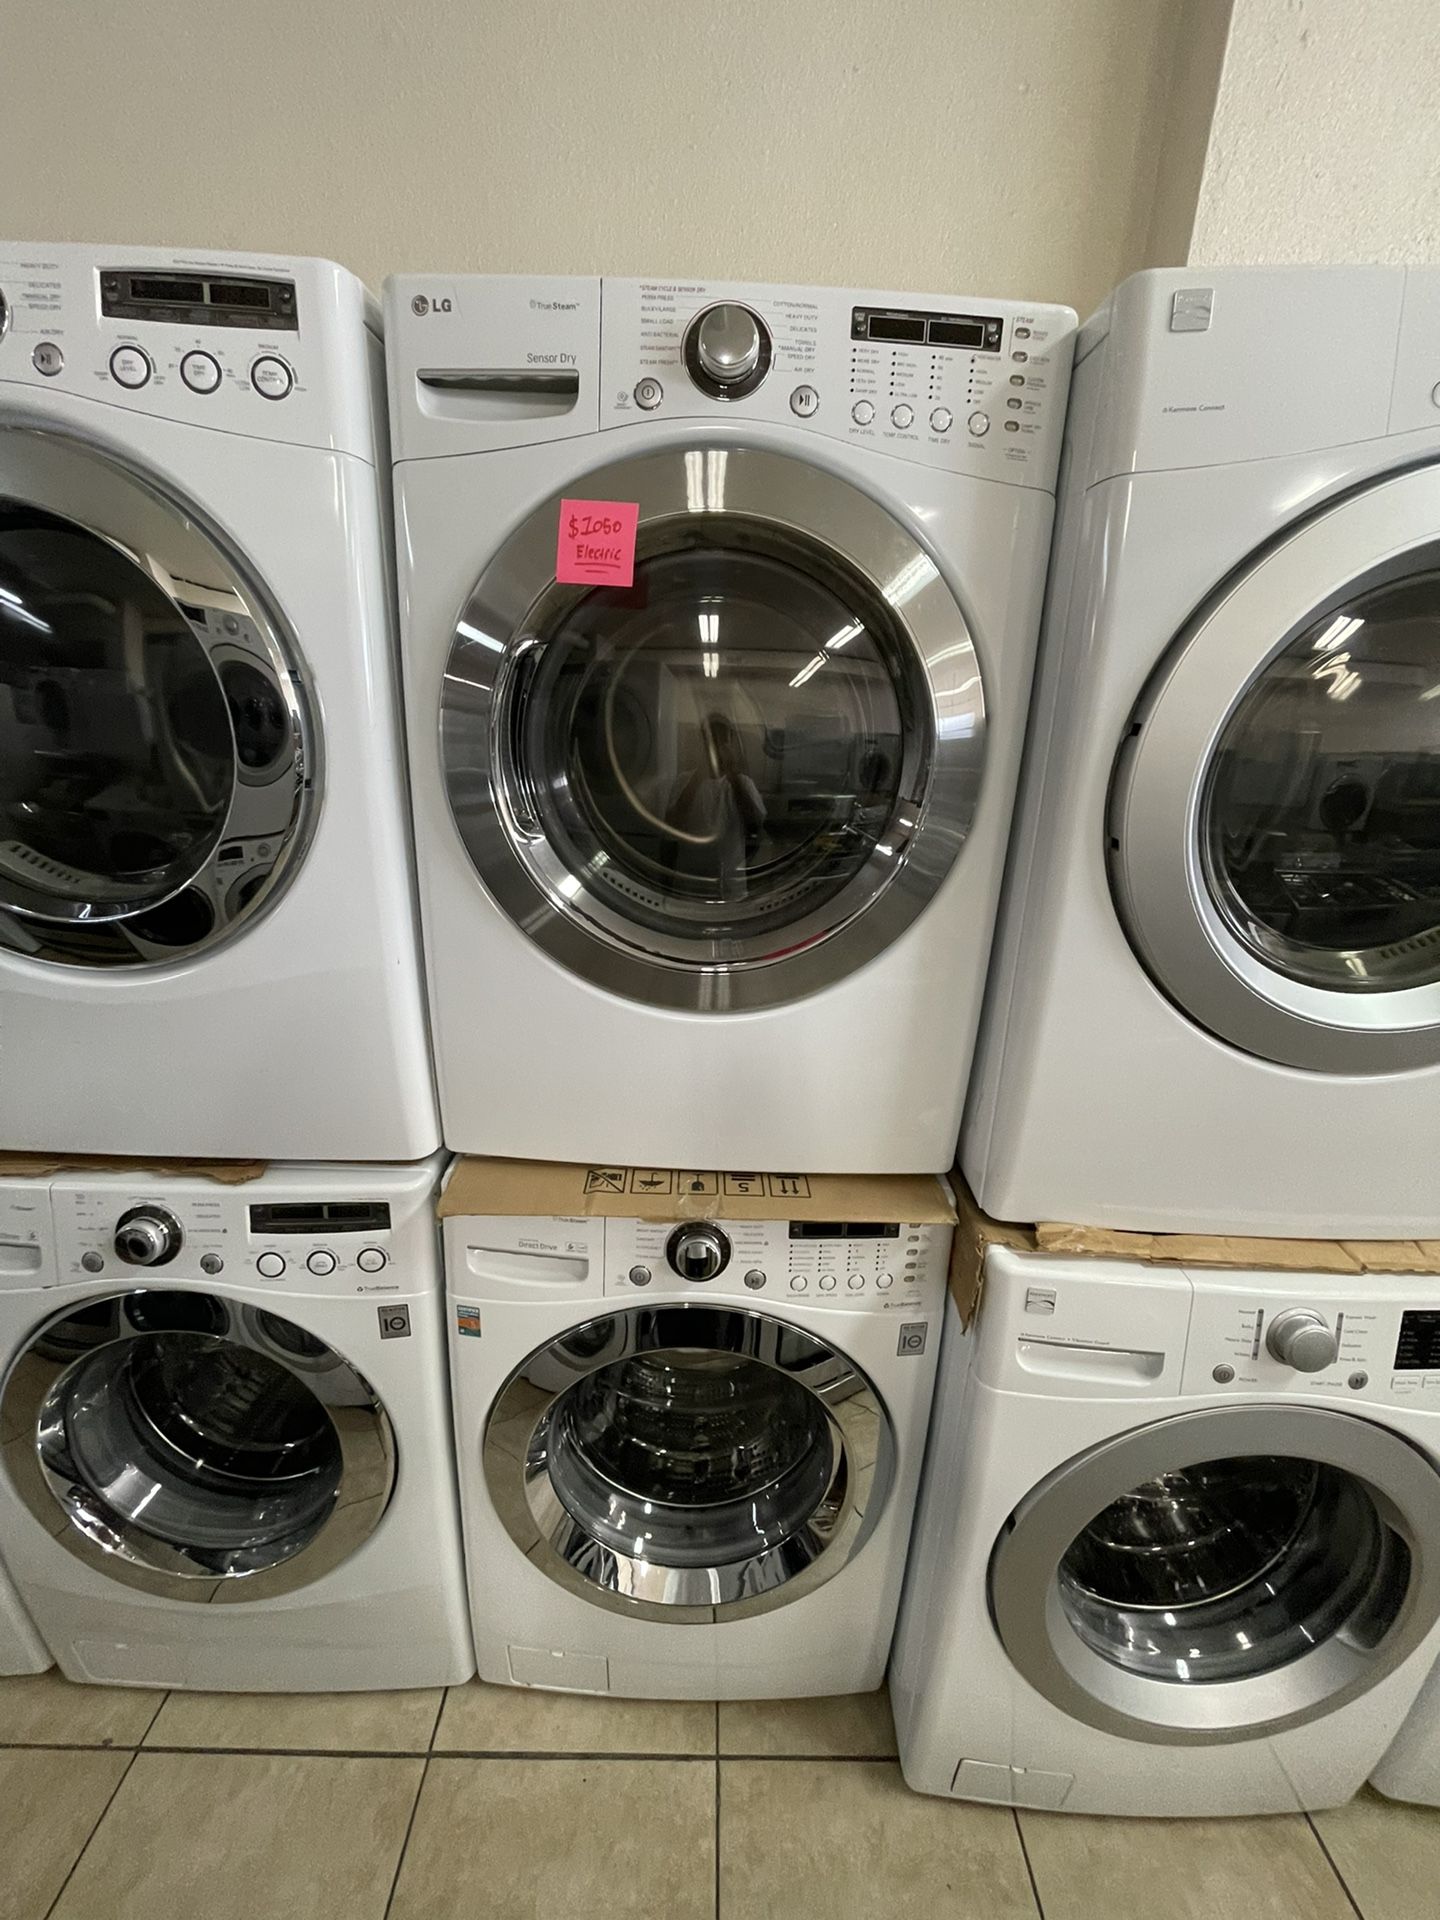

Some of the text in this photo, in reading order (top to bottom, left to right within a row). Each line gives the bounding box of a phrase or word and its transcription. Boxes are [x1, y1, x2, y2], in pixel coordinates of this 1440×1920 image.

[432, 298, 453, 313] LG
[526, 352, 577, 365] Sensor Dry
[848, 427, 876, 437] DRY LEVEL
[882, 431, 920, 442] TEMP CONTROL
[568, 514, 622, 539] $1050
[576, 544, 622, 561] Electric
[518, 1240, 540, 1249] Direct
[540, 1241, 558, 1251] Drive
